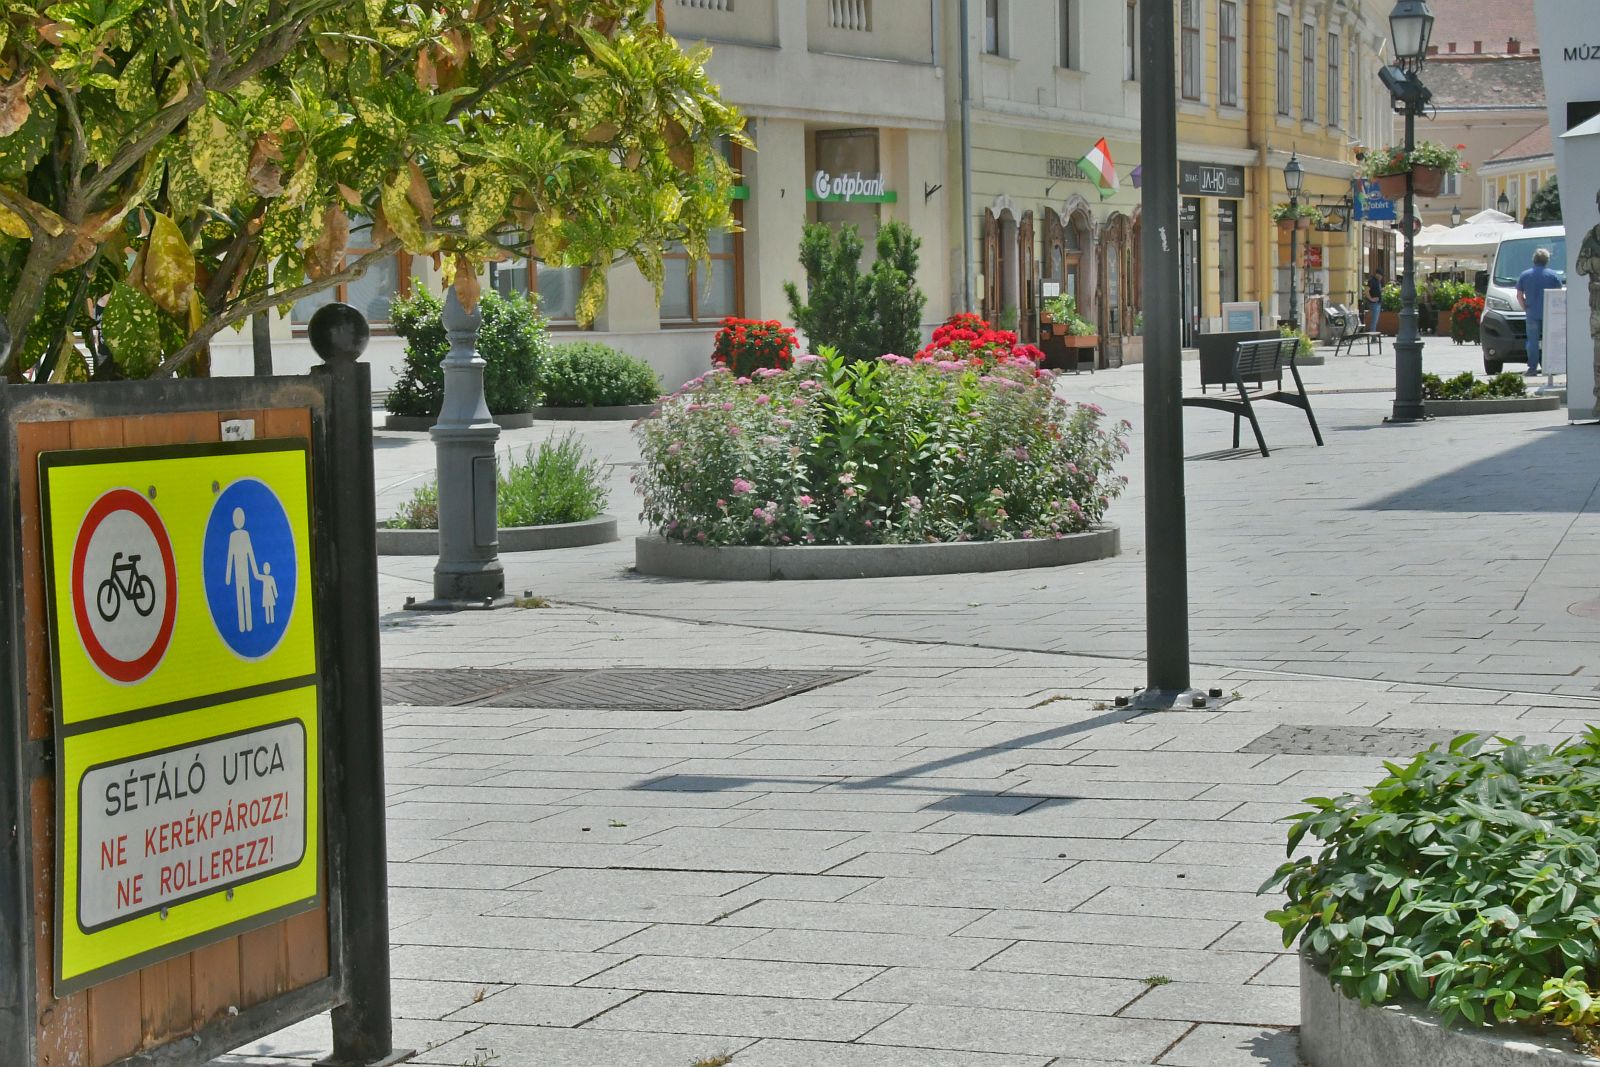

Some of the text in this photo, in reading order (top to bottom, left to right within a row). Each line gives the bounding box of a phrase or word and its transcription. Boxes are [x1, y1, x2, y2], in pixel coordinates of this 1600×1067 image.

[1563, 43, 1600, 61] MÚZ
[780, 188, 785, 198] 7
[105, 742, 285, 816] SÉTÁLÓ UTCA
[101, 791, 289, 871] NE KERÉKPÁROZZ!
[117, 835, 274, 909] NE ROLLEREZZ!
